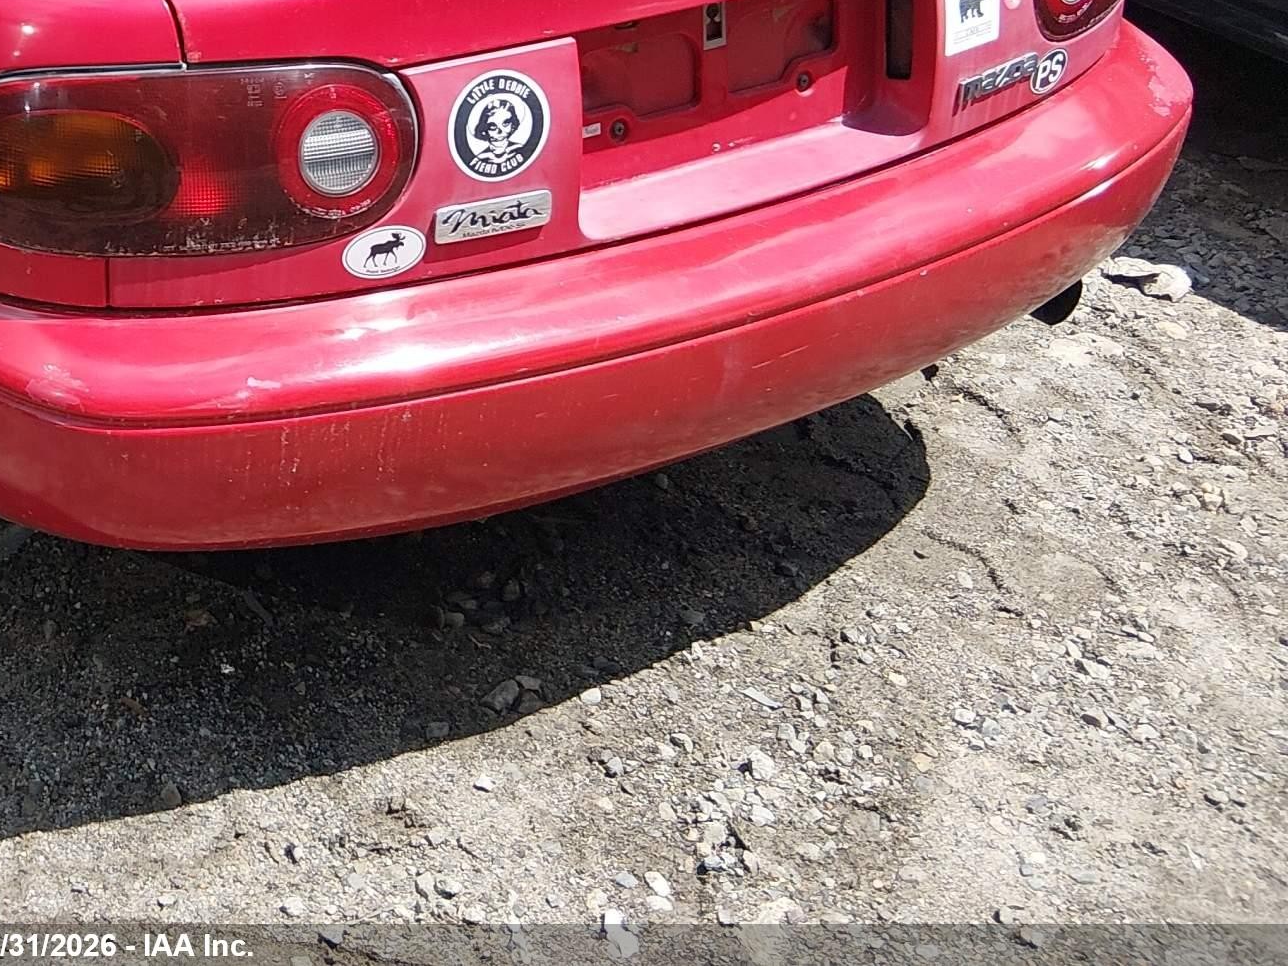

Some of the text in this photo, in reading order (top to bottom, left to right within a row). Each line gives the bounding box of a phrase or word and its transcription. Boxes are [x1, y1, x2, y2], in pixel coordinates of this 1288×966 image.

[1035, 53, 1065, 90] PS
[466, 78, 531, 105] LITTLE DEBBIE
[469, 153, 525, 175] FIEND CLUB
[442, 200, 543, 235] Miata
